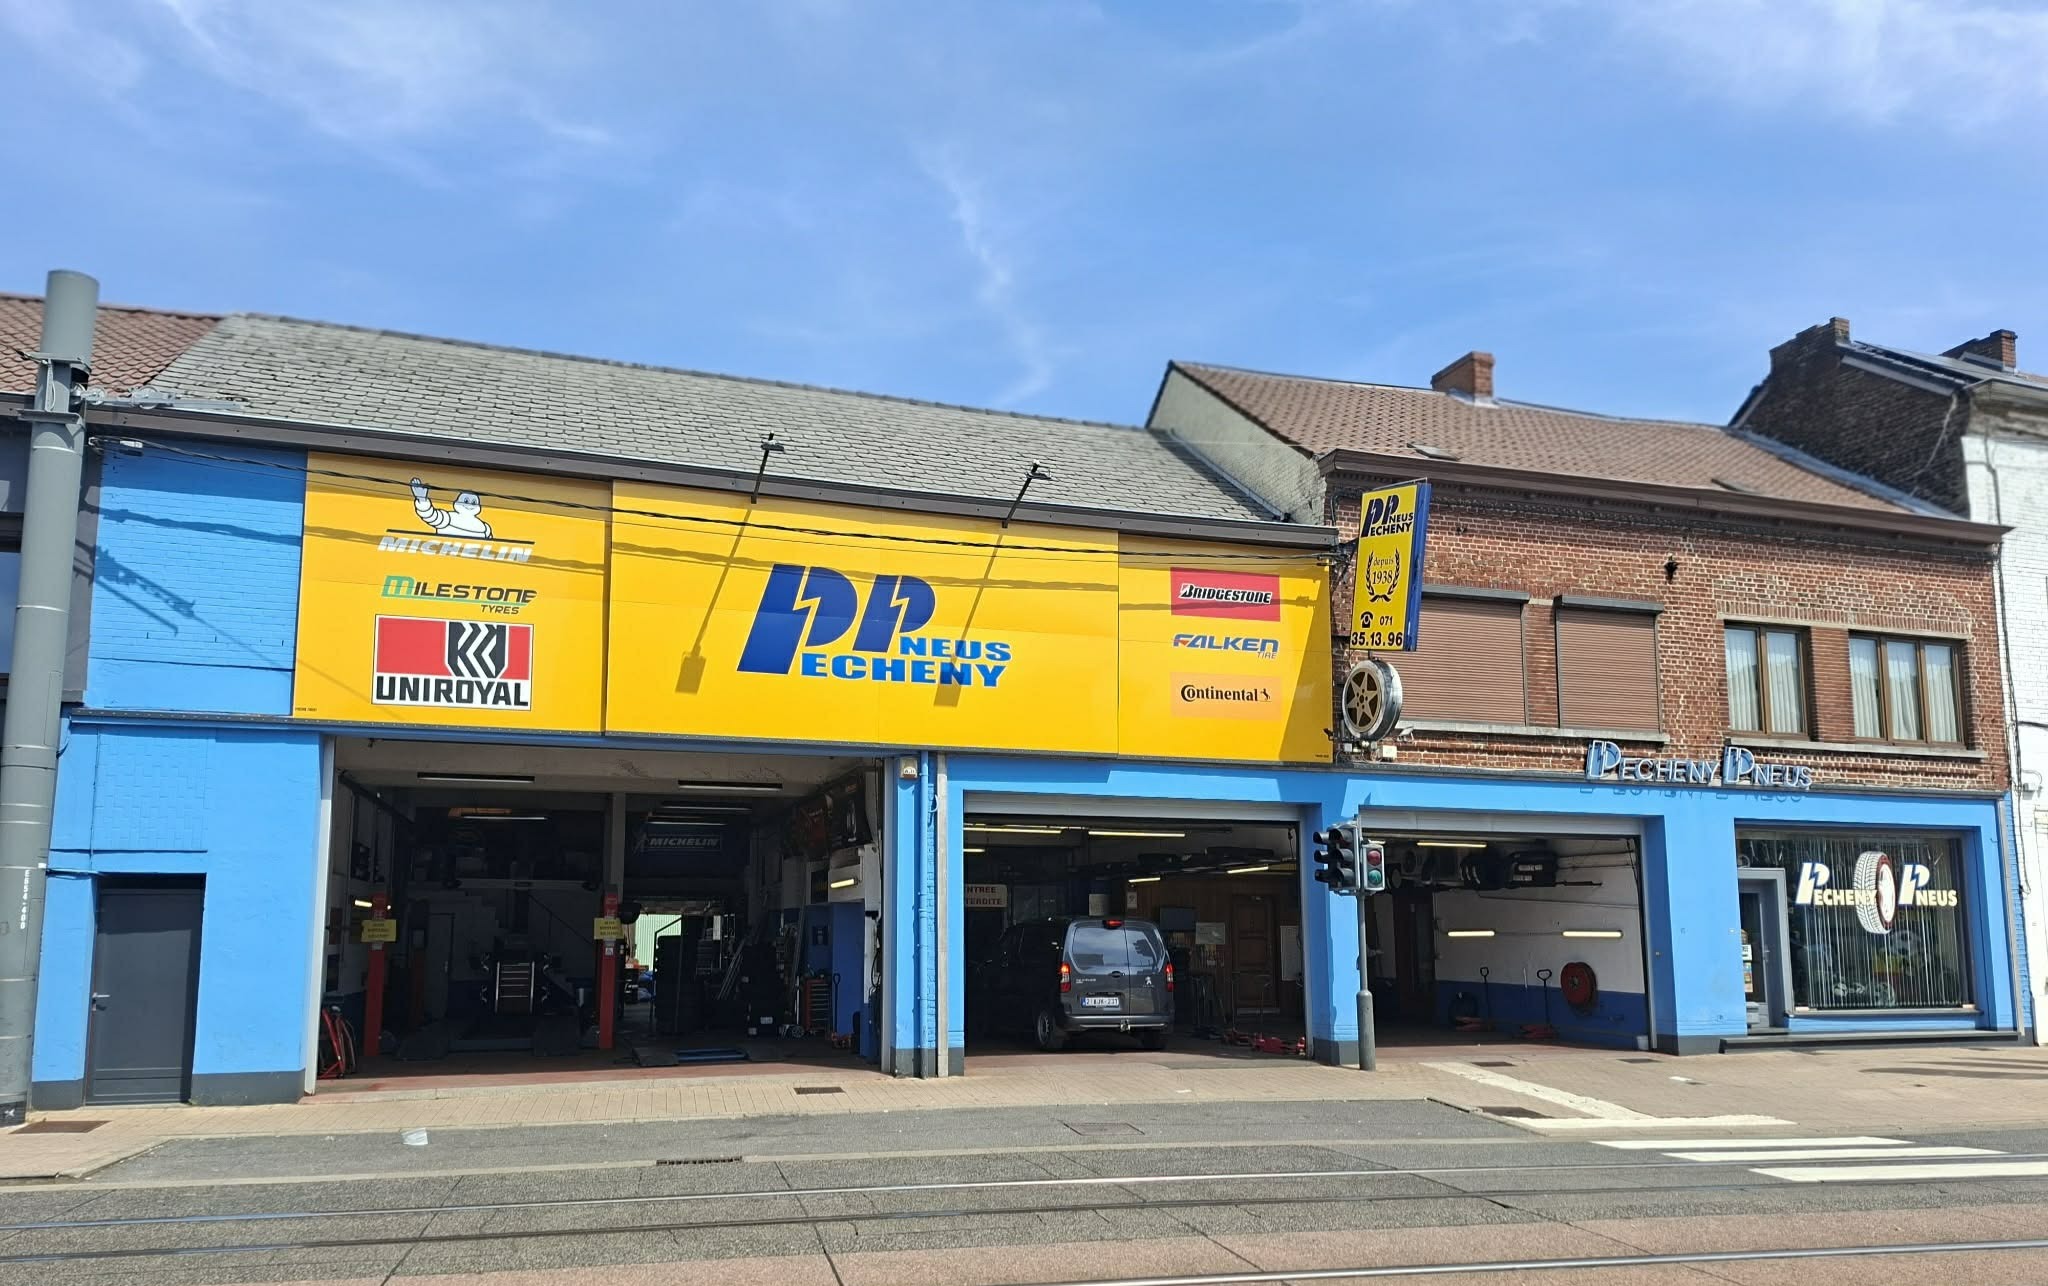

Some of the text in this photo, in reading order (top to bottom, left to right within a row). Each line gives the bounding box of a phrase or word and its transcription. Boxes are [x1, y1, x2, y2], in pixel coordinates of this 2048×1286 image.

[377, 536, 533, 563] MICHELIN
[1373, 556, 1394, 568] depuis
[1372, 570, 1393, 585] 1938
[381, 575, 538, 604] MILESTONE
[1180, 583, 1273, 604] BRIDGESTONE
[480, 604, 520, 615] TYRES
[1379, 615, 1393, 626] 071
[1173, 633, 1279, 653] FALKEN
[1351, 631, 1403, 646] 35.13.96
[376, 675, 529, 707] UNIROYAL
[1180, 684, 1259, 702] Continental
[1586, 740, 1814, 788] PECHENY PNEUS
[649, 837, 720, 848] MICHELIN
[966, 886, 998, 894] NTREE
[1898, 864, 1958, 907] PNEUS
